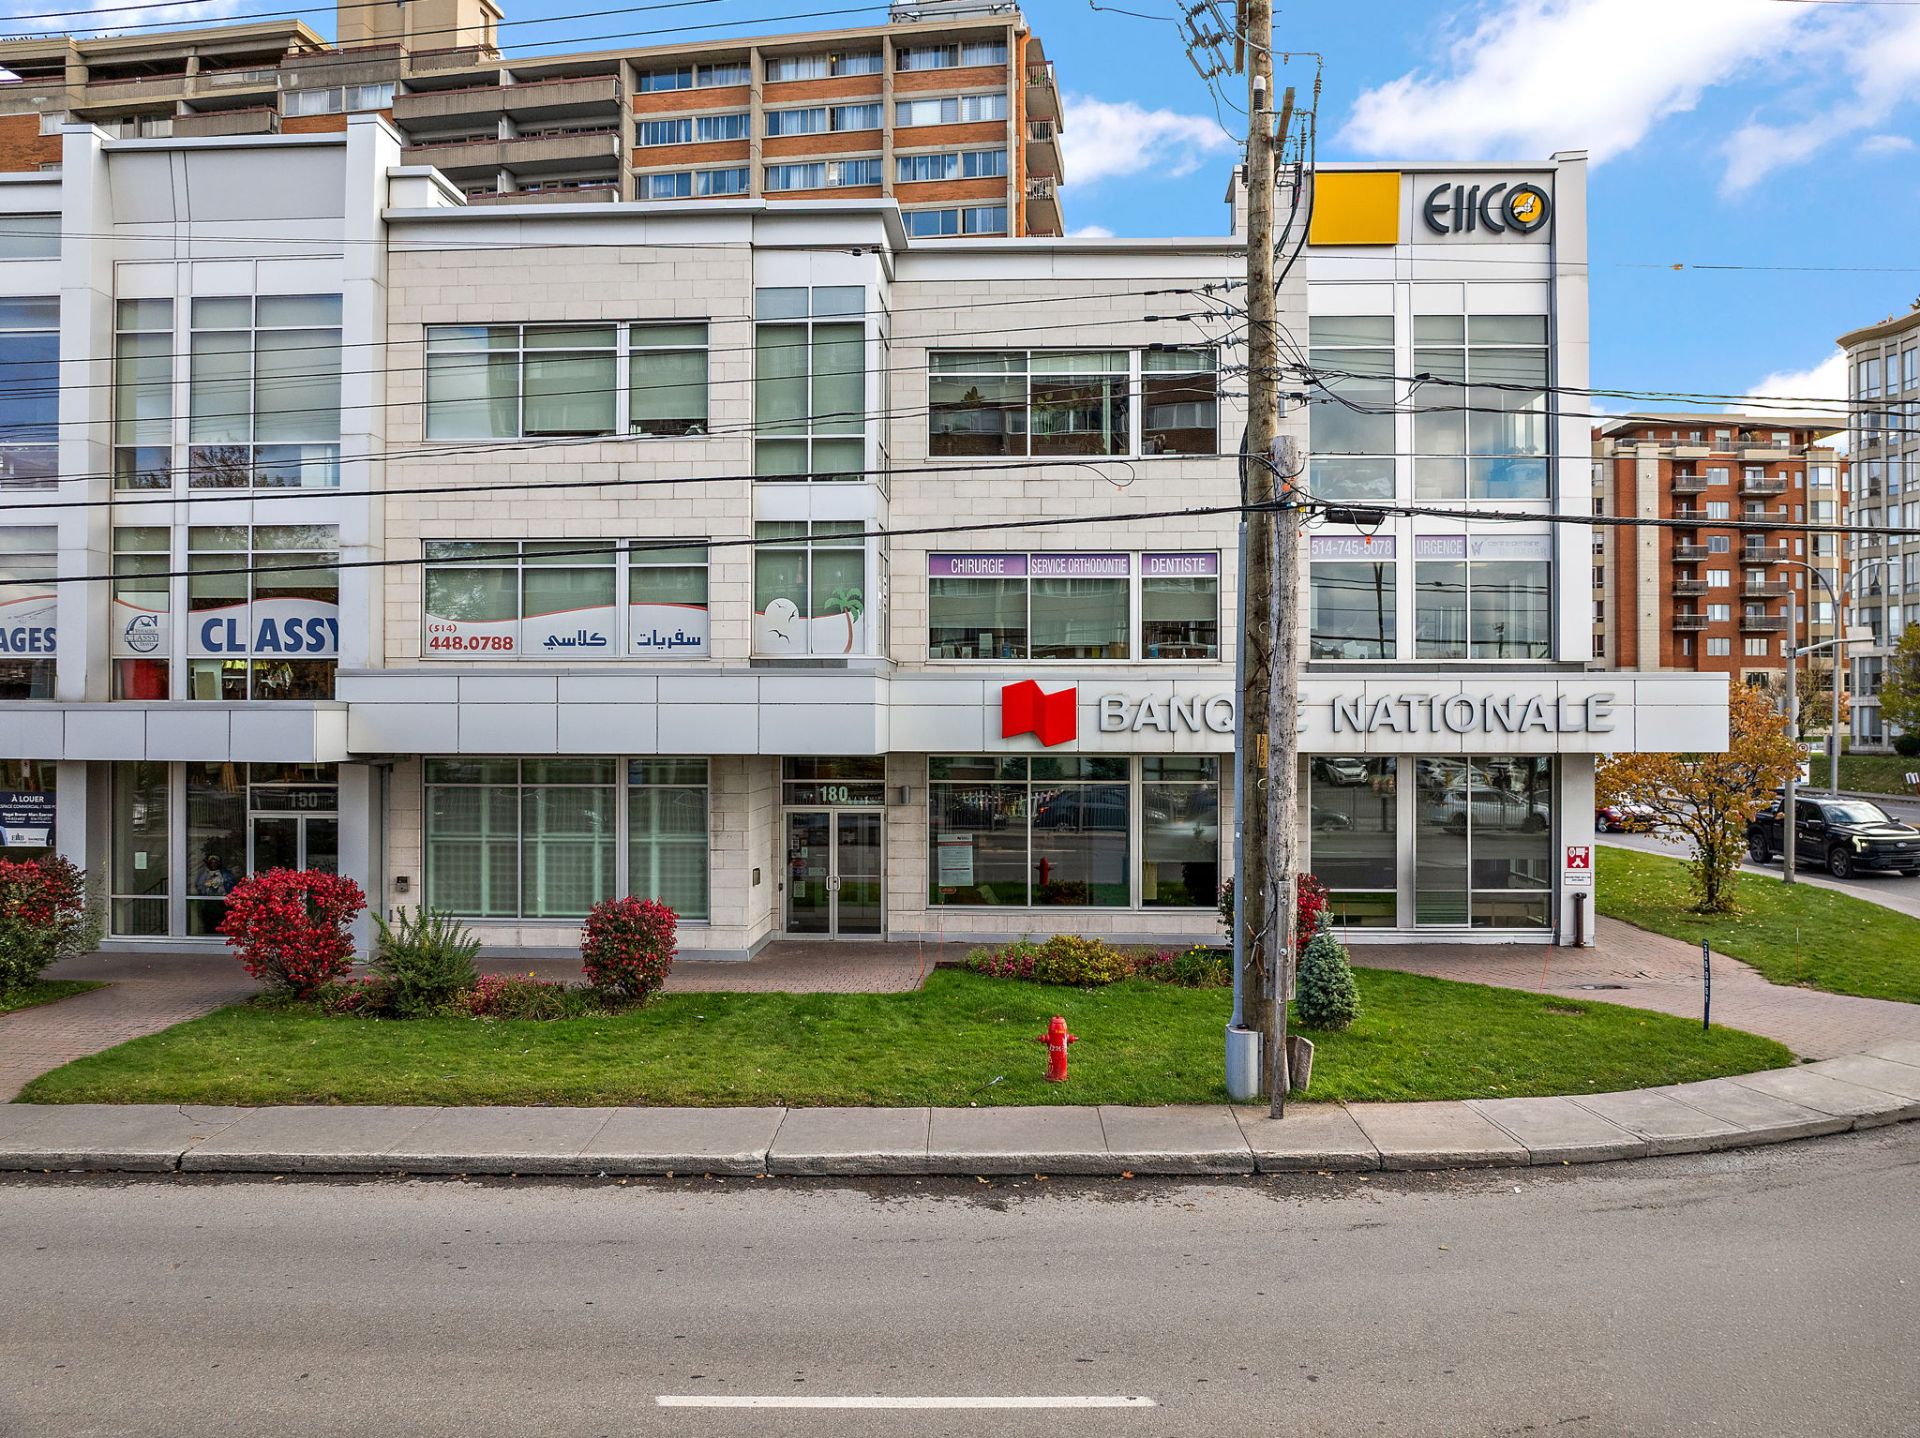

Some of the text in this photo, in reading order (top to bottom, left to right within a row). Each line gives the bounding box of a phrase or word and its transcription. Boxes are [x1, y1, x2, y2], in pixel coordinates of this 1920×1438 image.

[1417, 539, 1463, 554] URGENCE
[951, 559, 1004, 574] CHIRURGIE
[1031, 559, 1127, 573] SERVICE ORTHODONTIE
[1151, 558, 1206, 572] DENTISTE
[428, 623, 457, 633] (514)
[429, 636, 514, 651] 448.0788
[542, 628, 701, 651] سفريات كلاسي
[1333, 693, 1616, 733] NATIONALE
[11, 794, 18, 802] À
[290, 792, 318, 808] 150
[820, 786, 848, 801] 180
